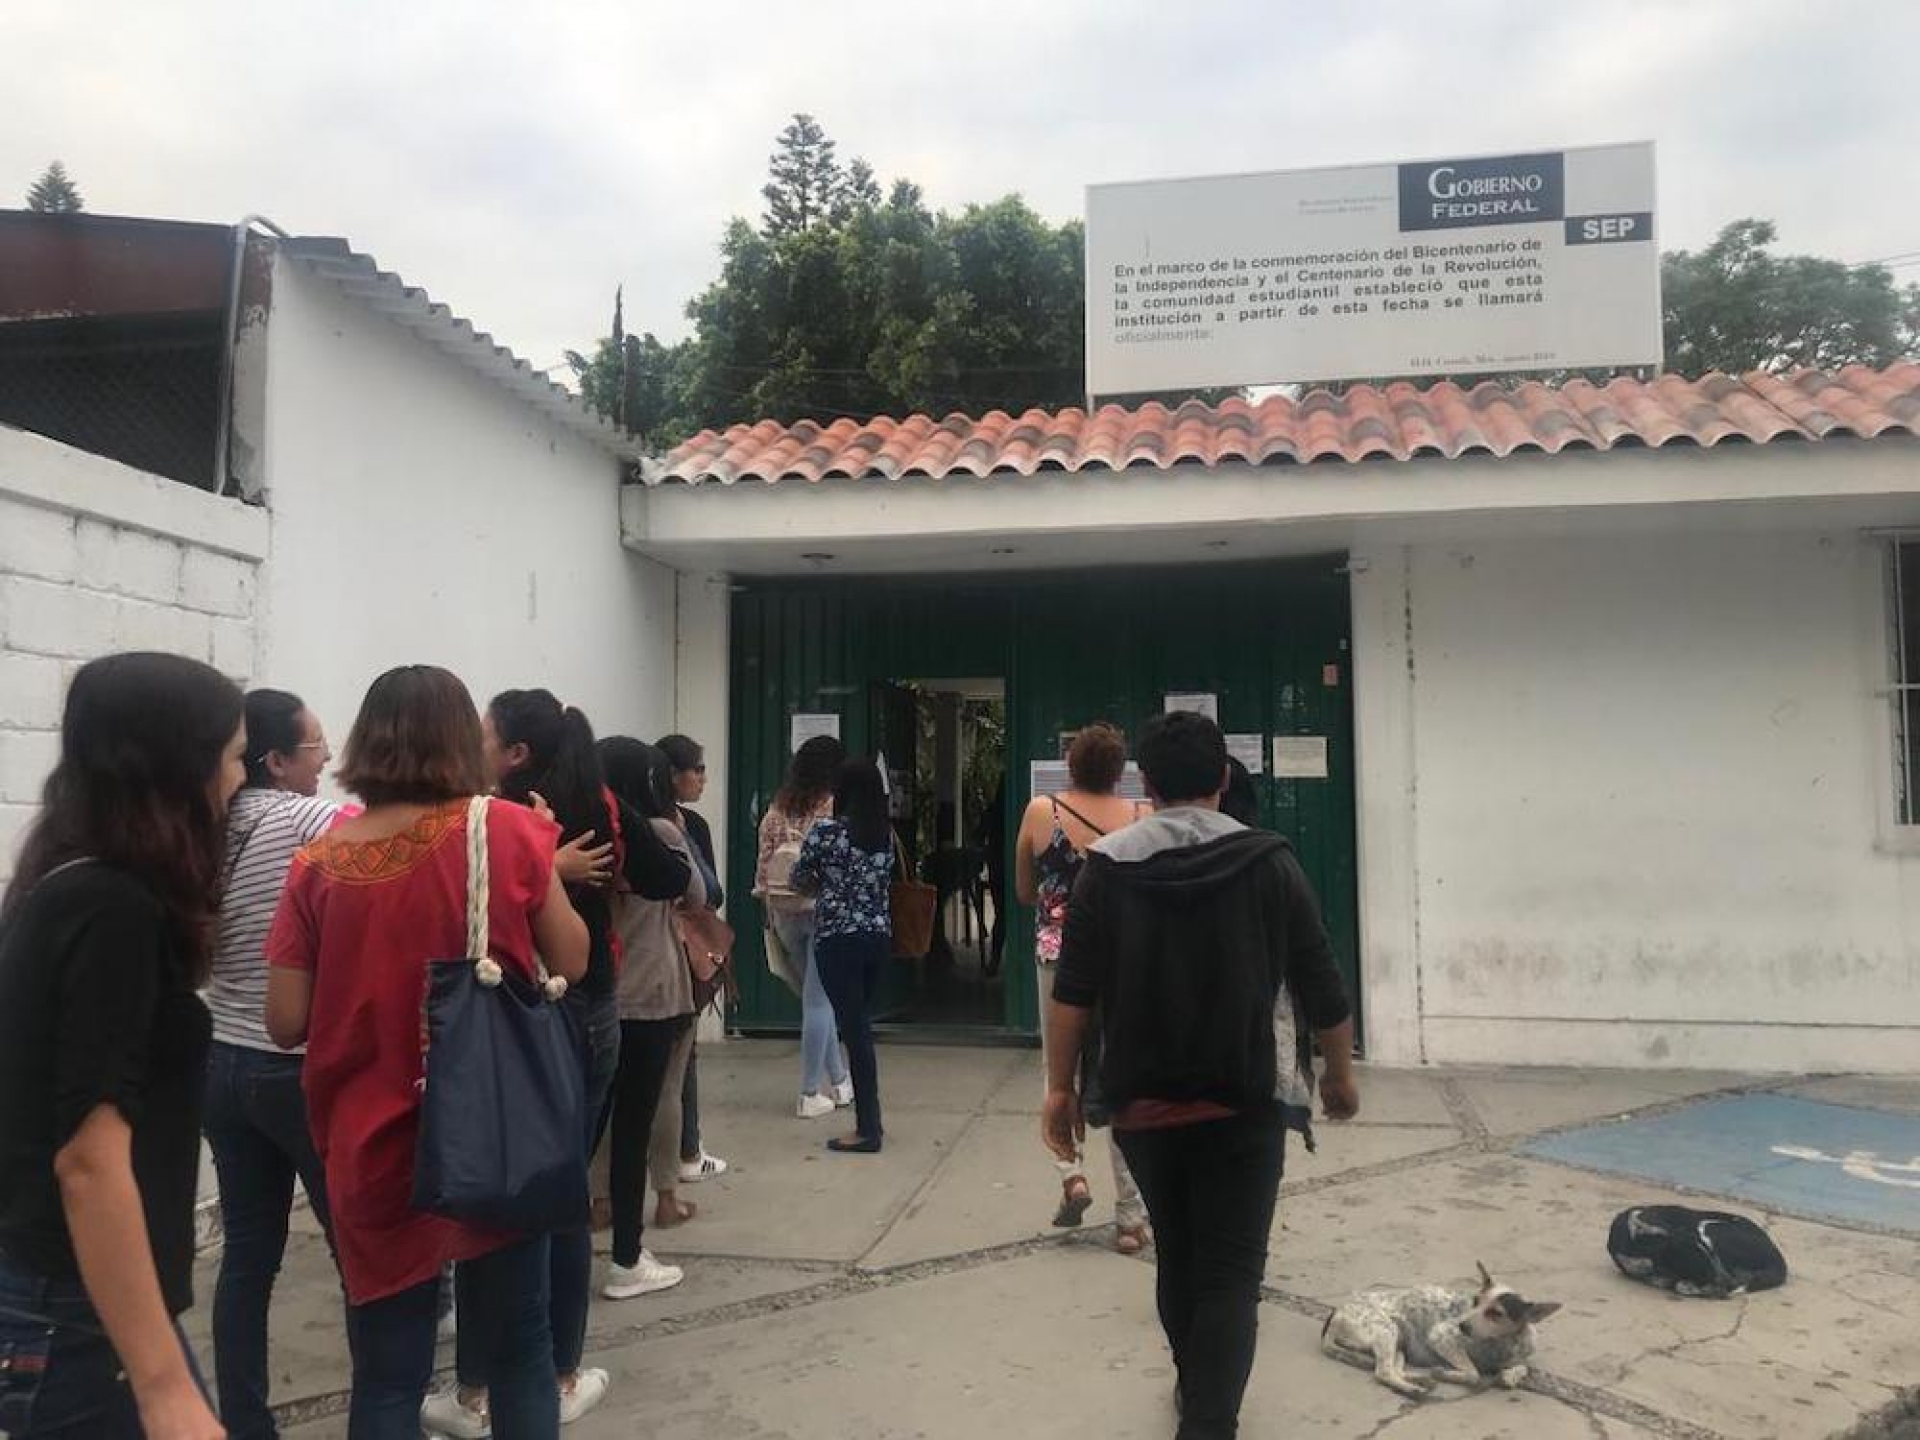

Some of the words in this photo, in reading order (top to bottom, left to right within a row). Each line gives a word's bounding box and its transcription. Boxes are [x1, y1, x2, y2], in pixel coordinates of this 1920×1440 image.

[1428, 167, 1542, 198] GOBIERNO
[1431, 198, 1540, 220] FEDERAL
[1582, 217, 1636, 239] SEP
[1115, 264, 1135, 277] En
[1140, 263, 1153, 275] el
[1157, 262, 1205, 274] marco
[1209, 259, 1229, 271] de
[1233, 257, 1247, 269] la
[1251, 249, 1379, 268] conmemoración
[1384, 246, 1408, 260] del
[1413, 239, 1516, 259] Bicentenario
[1522, 239, 1542, 251] de
[1115, 282, 1128, 294] la
[1136, 275, 1249, 292] Independencia
[1257, 274, 1267, 288] y
[1275, 271, 1289, 284] el
[1297, 265, 1384, 282] Centenario
[1393, 265, 1413, 277] de
[1422, 262, 1435, 275] la
[1115, 299, 1128, 311] la
[1142, 292, 1235, 309] comunidad
[1249, 285, 1339, 302] estudiantil
[1354, 279, 1443, 297] estableció
[1458, 277, 1490, 292] que
[1505, 273, 1543, 287] esta
[1115, 311, 1202, 328] institución
[1215, 312, 1225, 322] a
[1239, 305, 1286, 322] partir
[1298, 304, 1319, 316] de
[1332, 302, 1368, 315] esta
[1383, 298, 1430, 312] fecha
[1444, 298, 1464, 308] se
[1478, 288, 1543, 306] llamará
